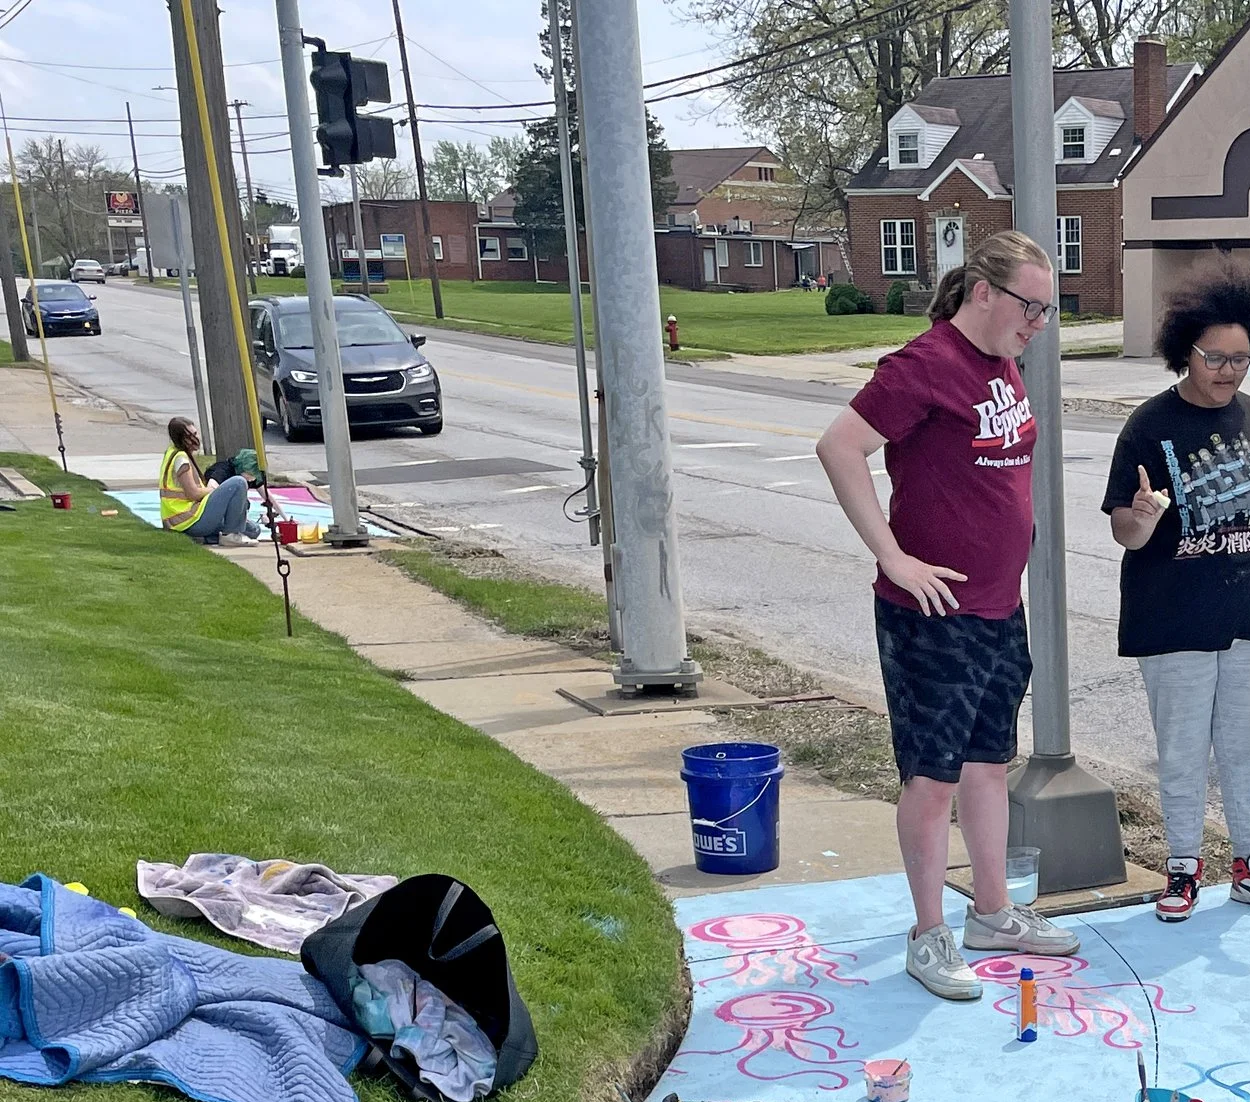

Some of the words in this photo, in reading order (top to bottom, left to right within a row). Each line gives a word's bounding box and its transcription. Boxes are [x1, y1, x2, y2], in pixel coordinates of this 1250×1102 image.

[988, 377, 1017, 413] Dr
[973, 396, 1033, 450] Pepper
[693, 832, 738, 853] OWE'S
